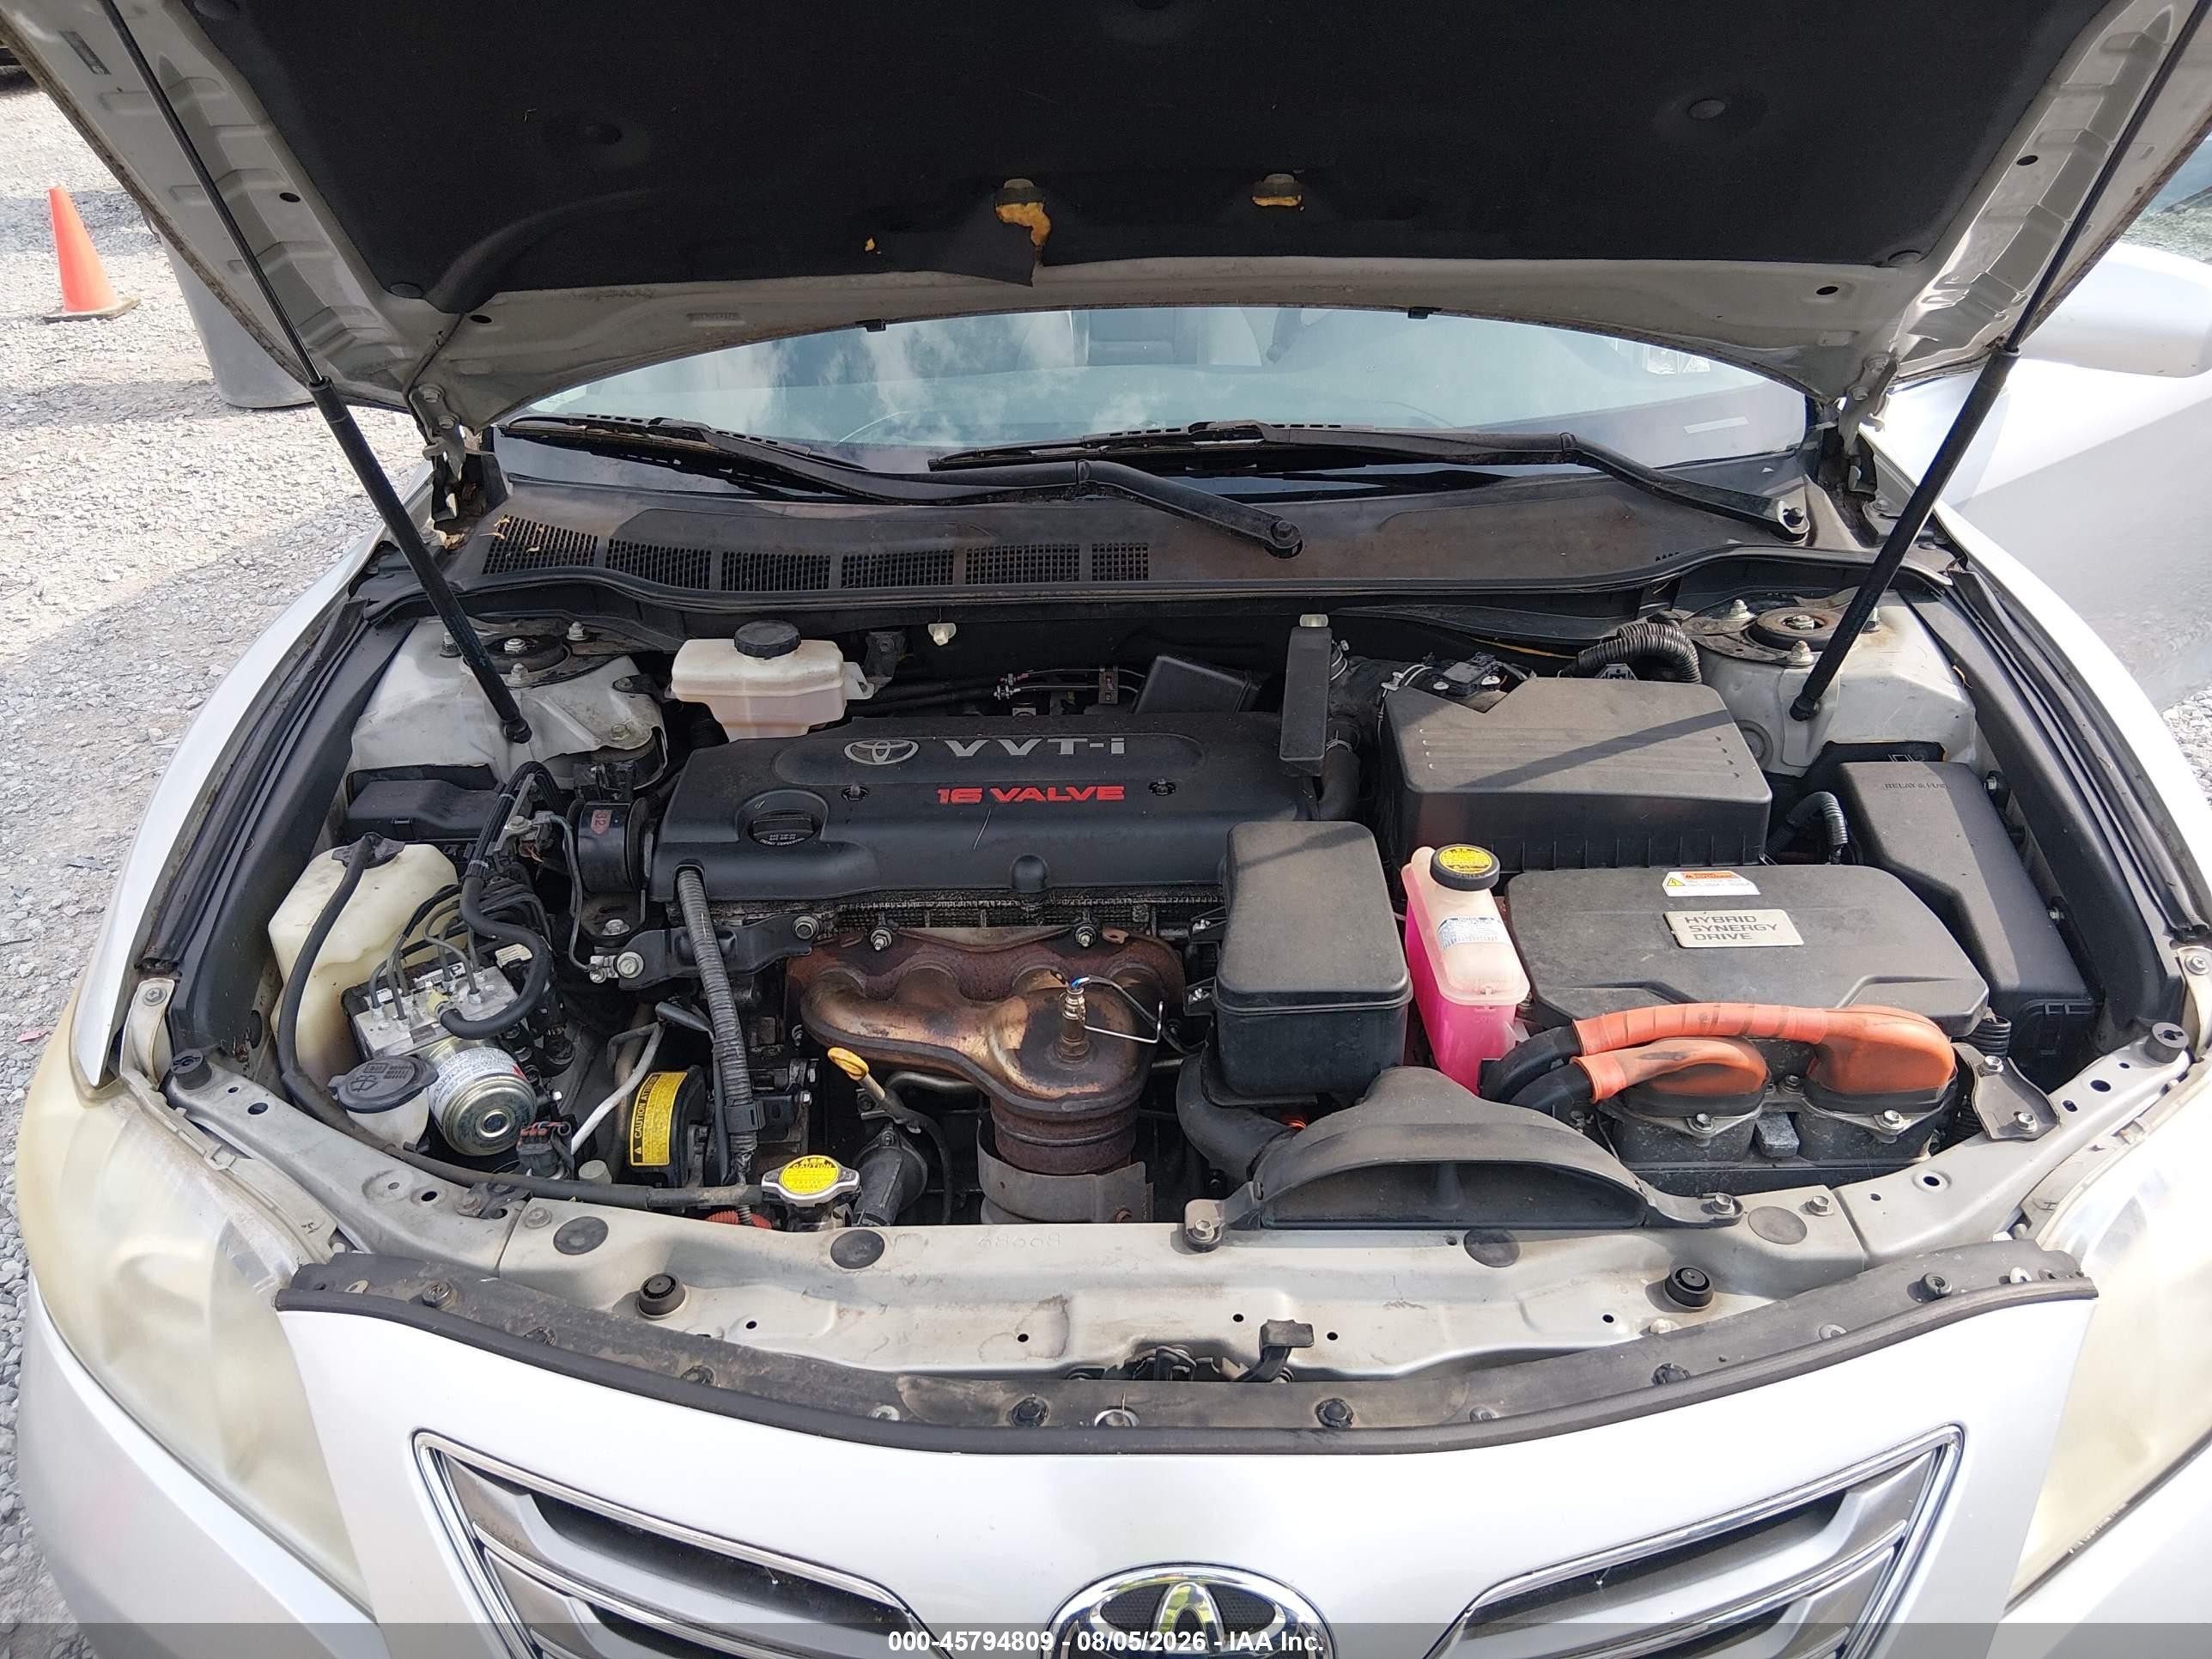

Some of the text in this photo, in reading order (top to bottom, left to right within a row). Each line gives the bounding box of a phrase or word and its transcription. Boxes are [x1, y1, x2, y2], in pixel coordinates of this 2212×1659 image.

[944, 737, 1126, 757] VVT-i
[937, 785, 1126, 804] 16 VALVE
[1684, 915, 1758, 924] HYBRID
[1688, 923, 1778, 933] SYNERGY
[1693, 933, 1753, 941] DRIVE
[634, 1103, 647, 1139] CAUTION
